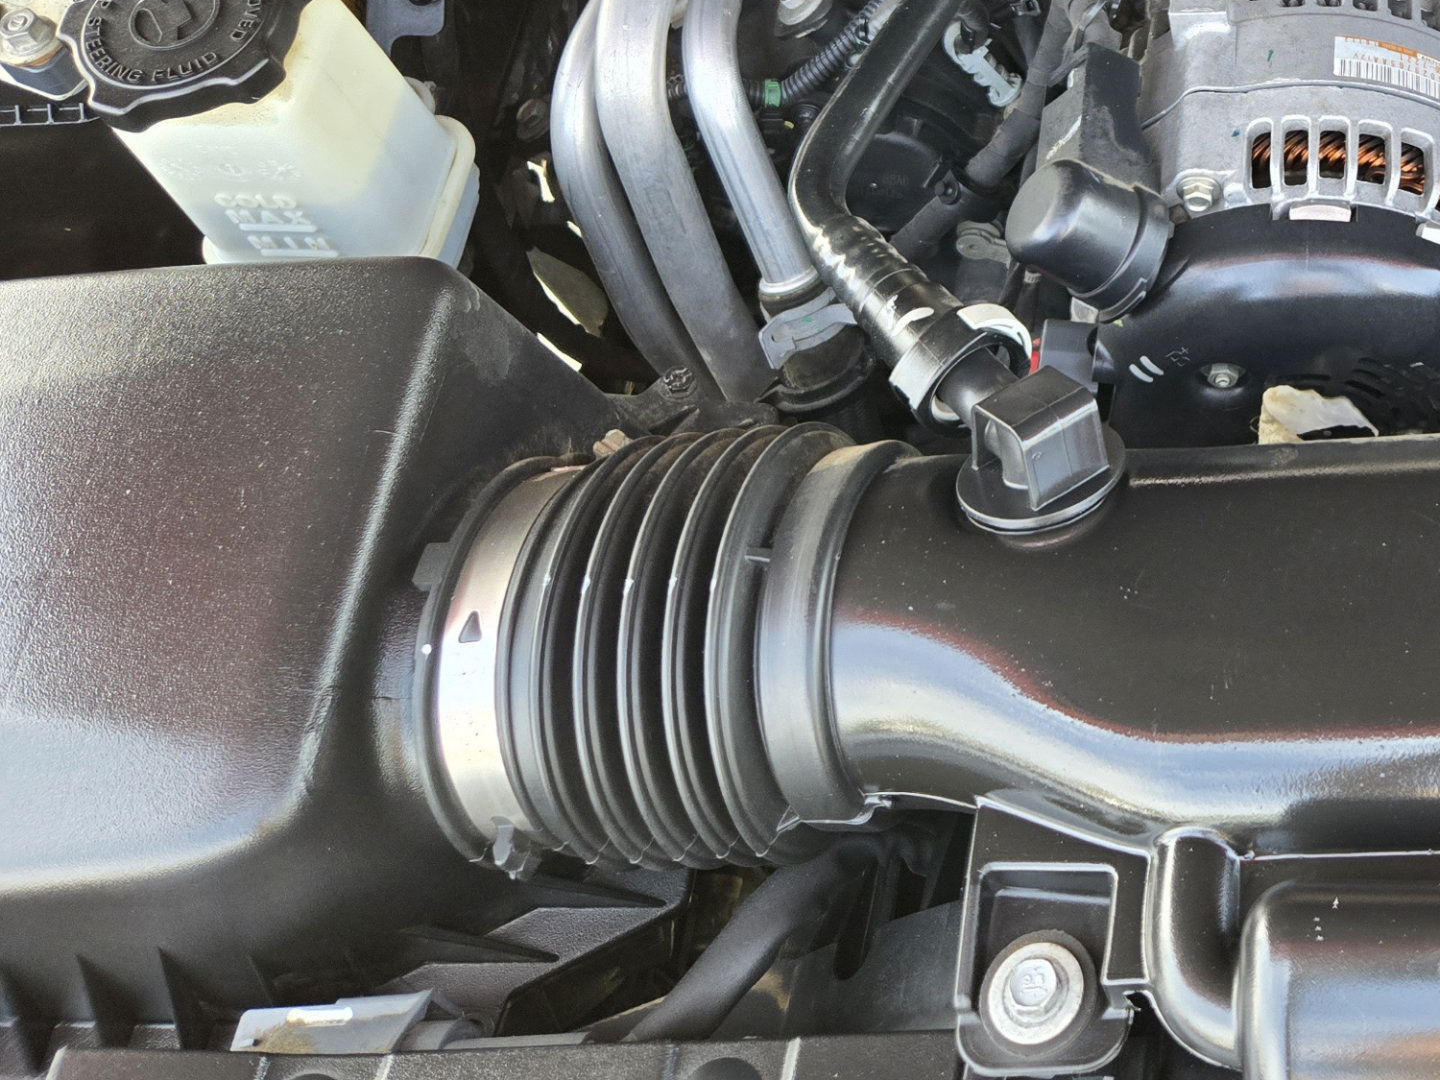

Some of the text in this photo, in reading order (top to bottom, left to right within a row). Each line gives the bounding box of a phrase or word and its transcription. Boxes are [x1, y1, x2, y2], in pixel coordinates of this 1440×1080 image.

[86, 16, 145, 84] STEERING
[151, 51, 218, 83] FLUID
[214, 192, 297, 209] COLD
[225, 209, 313, 225] MAX
[247, 235, 331, 250] MIN
